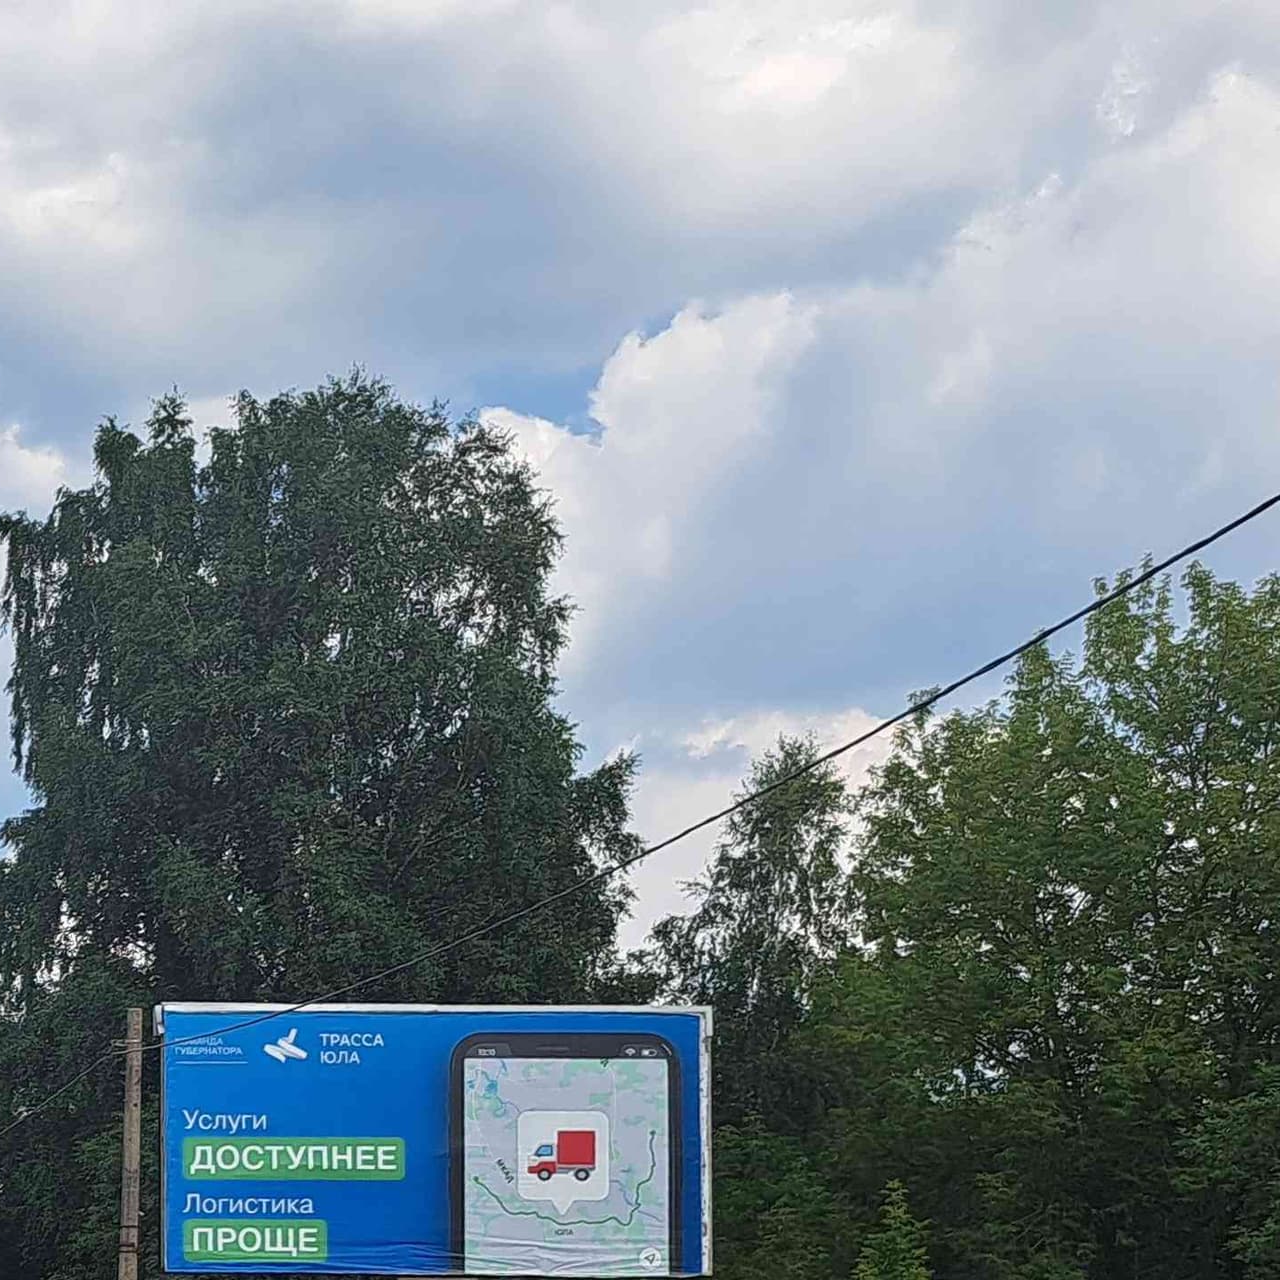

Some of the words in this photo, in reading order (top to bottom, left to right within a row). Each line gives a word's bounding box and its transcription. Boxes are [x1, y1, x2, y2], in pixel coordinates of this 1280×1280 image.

[175, 1046, 244, 1056] ГУБЕРНАТОРА
[320, 1033, 384, 1047] ТРАССА
[320, 1051, 360, 1065] ЮЛА
[182, 1109, 268, 1134] Услуги
[190, 1144, 397, 1175] ДОСТУПНЕЕ
[182, 1192, 315, 1214] Логистика
[192, 1226, 319, 1257] ПРОЩЕ
